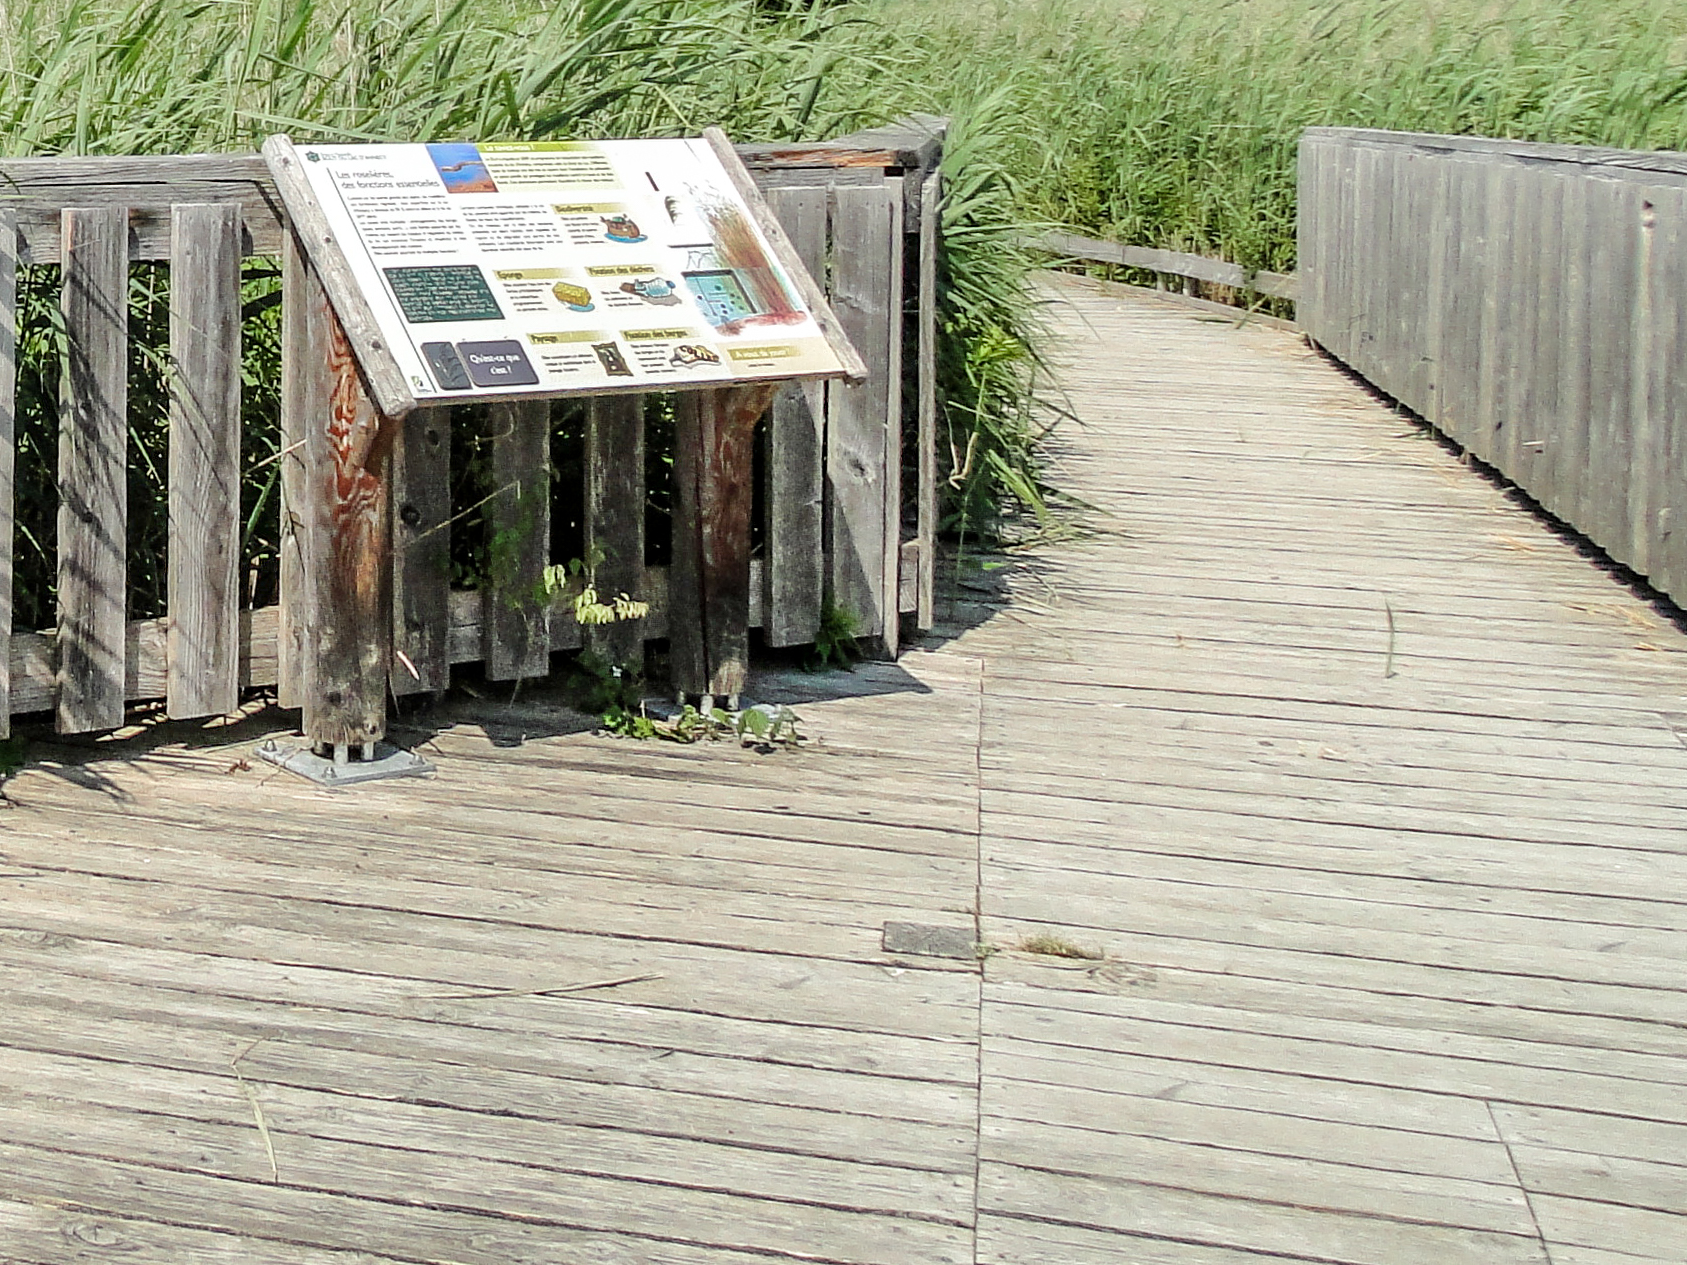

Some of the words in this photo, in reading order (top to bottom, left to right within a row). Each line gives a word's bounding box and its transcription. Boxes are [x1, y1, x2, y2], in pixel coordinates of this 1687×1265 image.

[335, 170, 351, 179] Les
[341, 181, 356, 190] des
[356, 180, 394, 189] fonctions
[395, 179, 441, 188] essentielles
[588, 267, 616, 276] Fixation
[617, 266, 629, 274] des
[629, 265, 655, 273] déchets
[623, 331, 652, 340] Fixation
[652, 330, 664, 338] des
[664, 329, 688, 339] berges
[469, 353, 505, 365] Qu'est-ce
[505, 354, 521, 363] que
[489, 365, 508, 375] c'est
